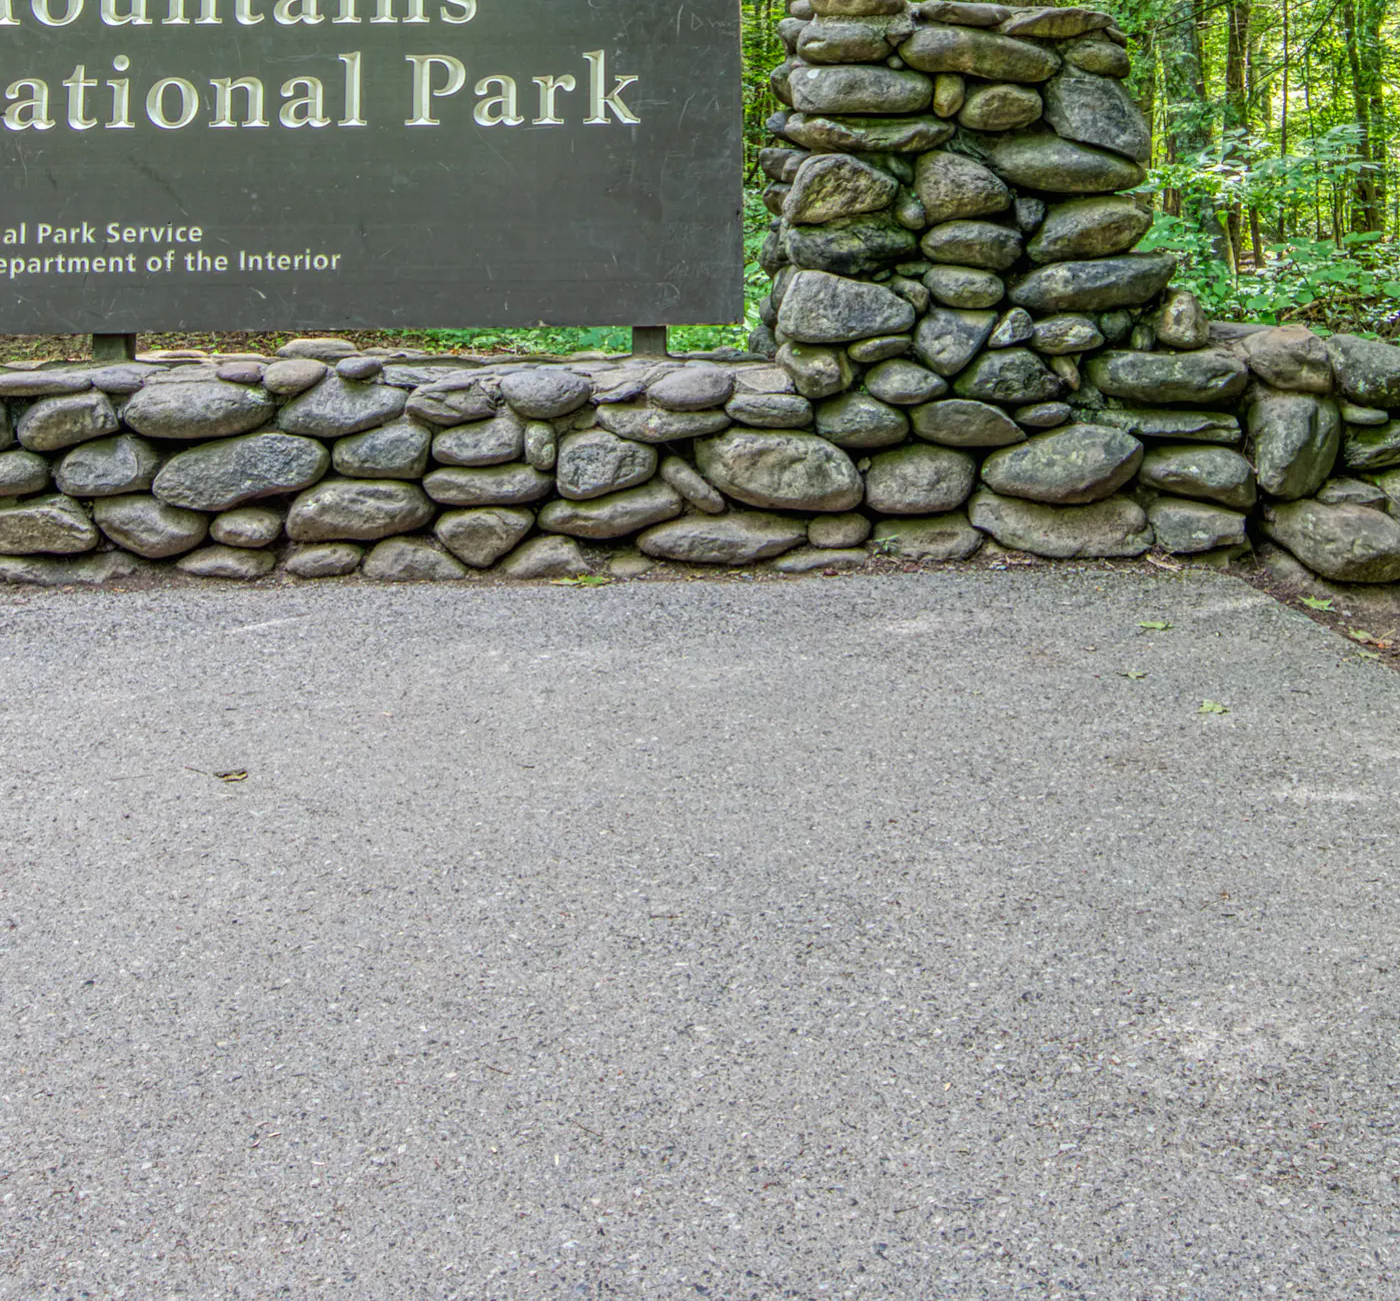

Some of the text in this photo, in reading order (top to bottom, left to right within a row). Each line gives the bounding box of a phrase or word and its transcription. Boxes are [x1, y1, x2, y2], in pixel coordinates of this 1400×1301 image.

[404, 48, 641, 127] Park
[37, 223, 97, 244] Park
[106, 222, 204, 243] Service
[146, 250, 176, 272] of
[184, 250, 228, 272] the
[239, 249, 342, 270] Interior
